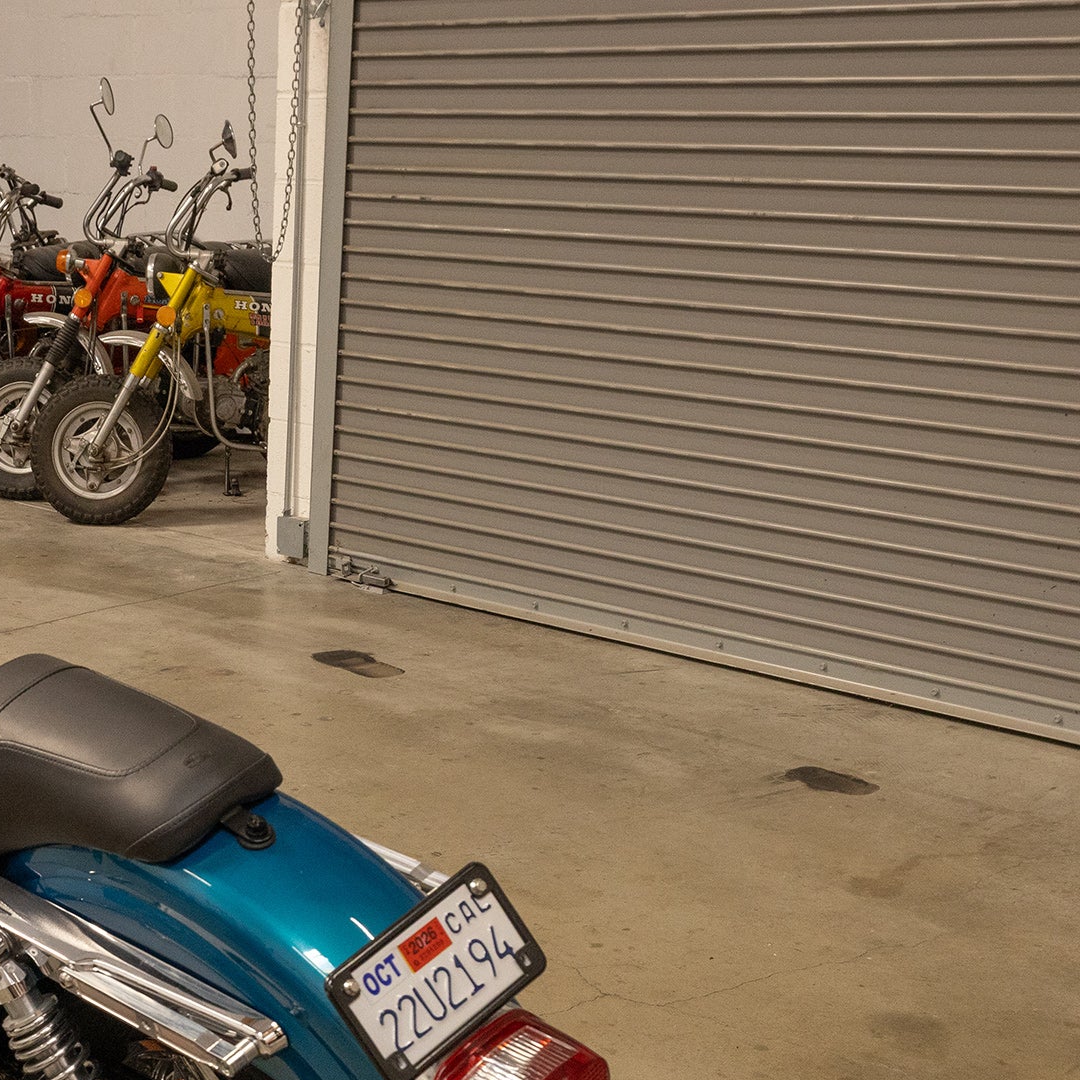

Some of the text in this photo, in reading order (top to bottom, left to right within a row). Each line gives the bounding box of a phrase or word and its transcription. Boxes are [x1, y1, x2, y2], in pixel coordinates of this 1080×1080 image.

[362, 953, 401, 996] OCT
[408, 927, 438, 955] 2026
[444, 895, 492, 934] CAL
[379, 925, 516, 1053] 22U2194
